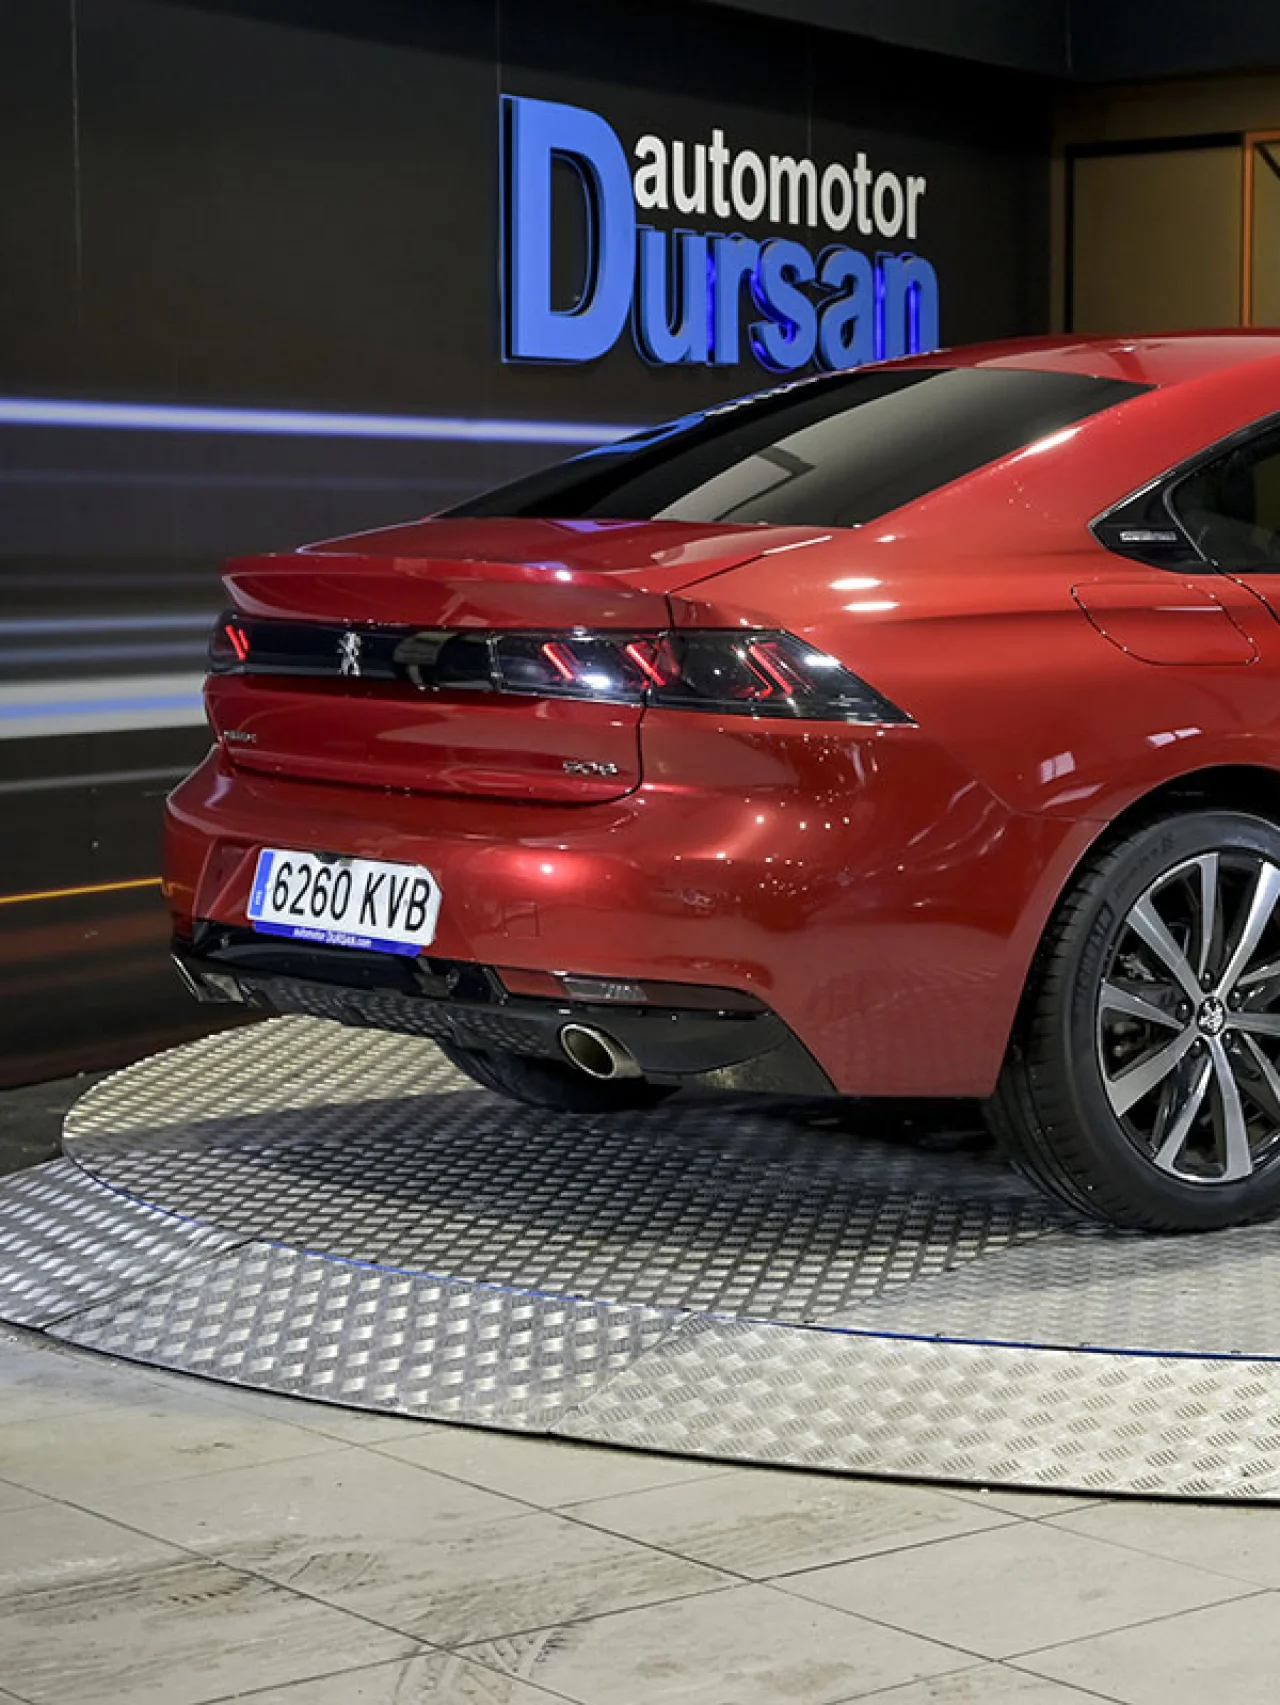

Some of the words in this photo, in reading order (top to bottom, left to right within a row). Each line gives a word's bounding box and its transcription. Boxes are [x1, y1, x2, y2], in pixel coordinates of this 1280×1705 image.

[500, 93, 940, 373] Dursan
[634, 129, 926, 239] automotor
[272, 861, 352, 920] 6260
[359, 872, 431, 931] KVB
